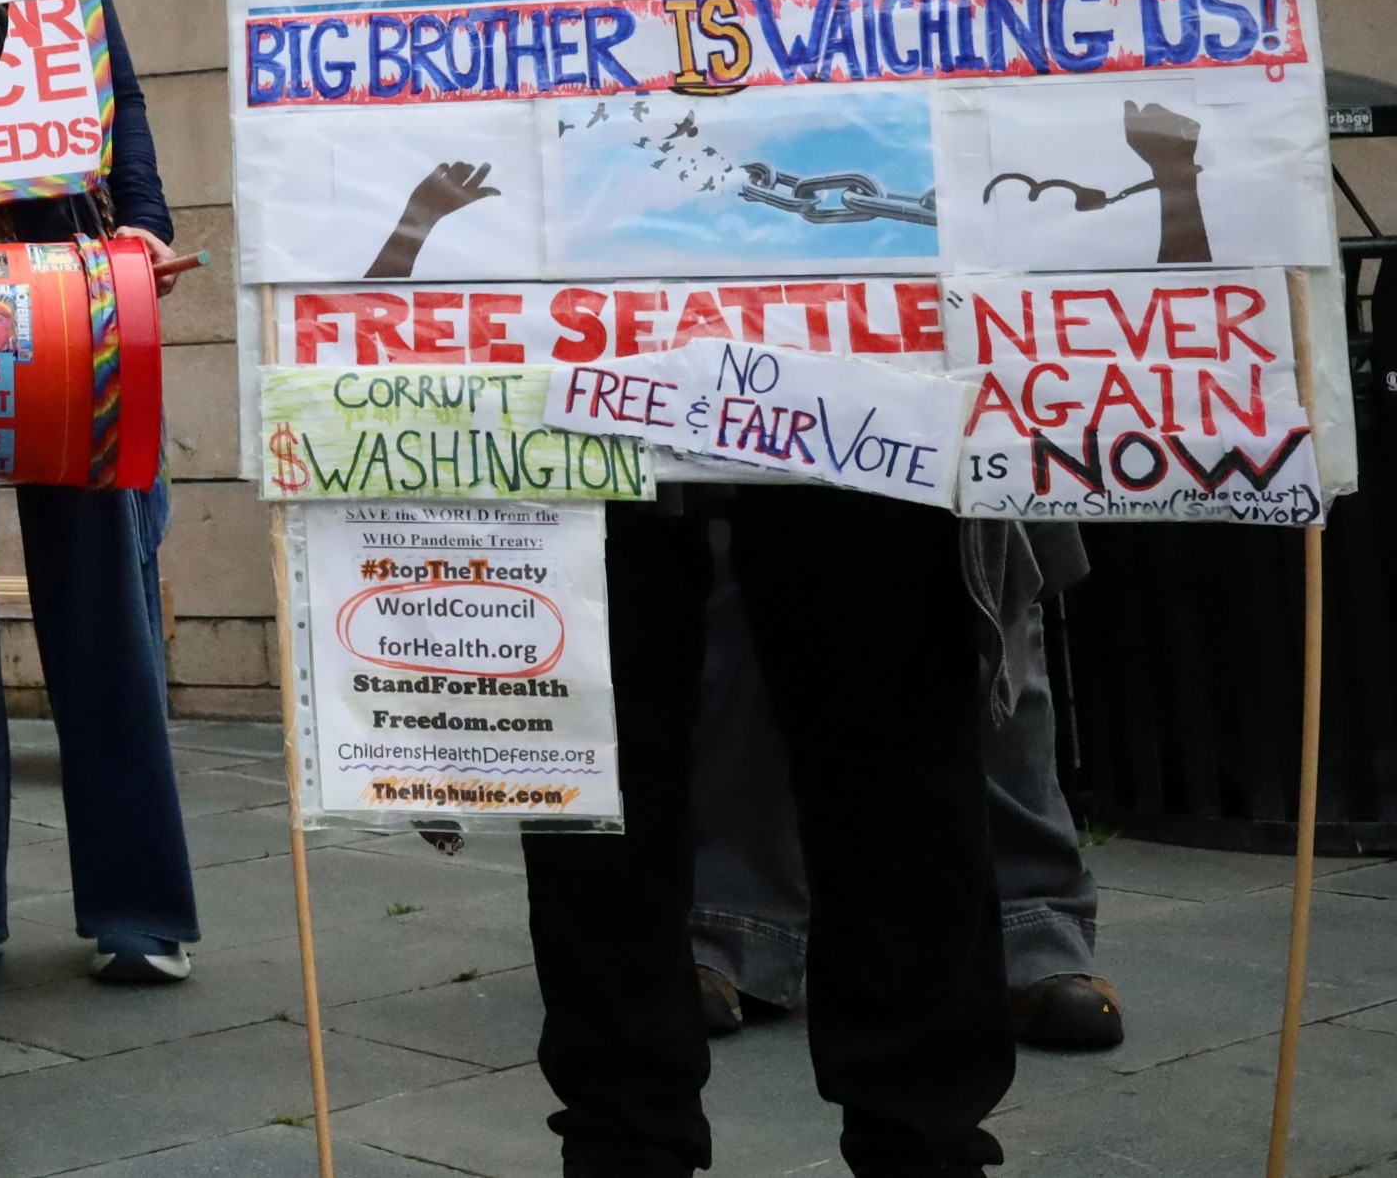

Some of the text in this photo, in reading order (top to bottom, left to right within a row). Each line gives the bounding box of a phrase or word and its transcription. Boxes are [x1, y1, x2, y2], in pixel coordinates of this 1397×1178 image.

[247, 16, 355, 108] BIG
[368, 4, 646, 97] BROTHER
[1329, 112, 1370, 126] rbage
[293, 282, 943, 365] FREE SEATTLE
[716, 344, 779, 395] NO
[334, 373, 522, 414] CORRUPT
[964, 363, 1267, 438] AGAIN
[565, 367, 678, 427] FREE
[716, 397, 817, 465] FAIR
[817, 396, 937, 487] VOTE
[970, 425, 1310, 496] IS NOW
[345, 508, 559, 522] SAVE the WORLD from the
[362, 533, 406, 545] WHO
[410, 533, 483, 547] Pandemic
[360, 558, 547, 583] #StopTheTreaty
[375, 597, 535, 619] WorldCouncil
[378, 636, 538, 664] forHealth.org
[353, 674, 569, 698] StandForHealth
[372, 710, 553, 733] Freedom.com
[338, 743, 596, 765] ChildrensHealthDefense.org
[372, 782, 563, 806] TheHighwire.com
